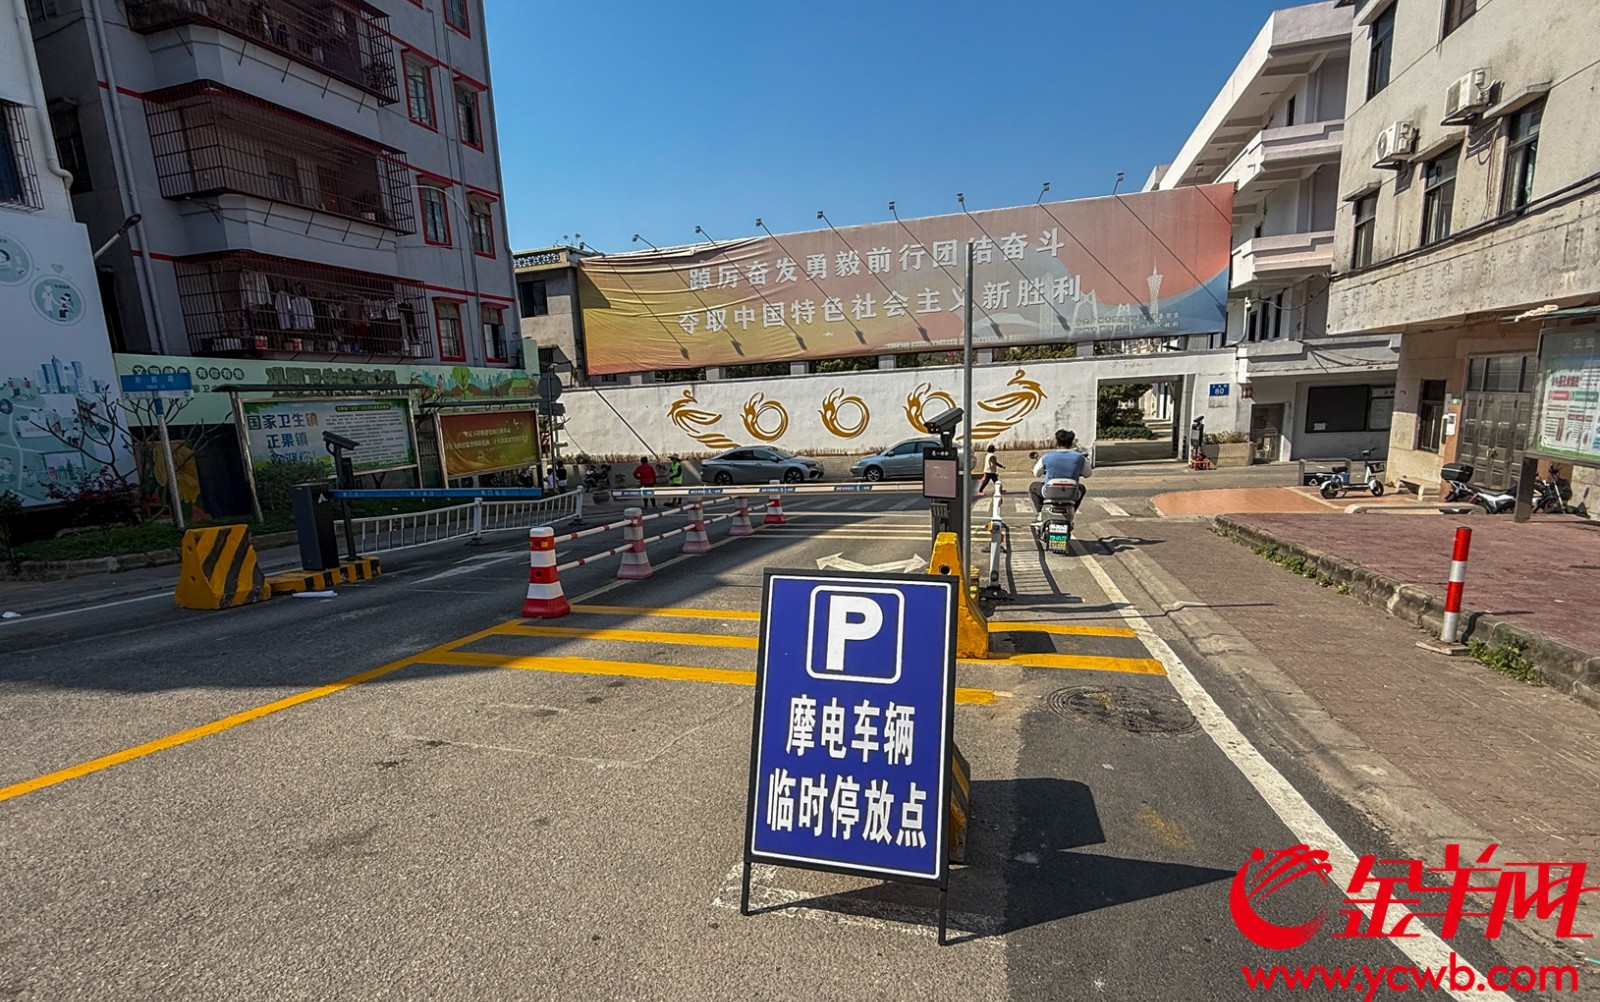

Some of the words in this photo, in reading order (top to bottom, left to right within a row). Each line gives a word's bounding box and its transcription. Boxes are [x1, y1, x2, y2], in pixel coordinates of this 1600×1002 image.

[689, 227, 1065, 291] 踔厉奋发勇毅前行团结奋斗
[678, 275, 1081, 334] 夺取中国特色社会主义新胜利
[247, 412, 318, 430] 国家卫生镇
[265, 432, 308, 449] 正果镇
[826, 595, 883, 671] P
[786, 694, 915, 766] 摩电车辆
[766, 768, 927, 848] 临时停放点
